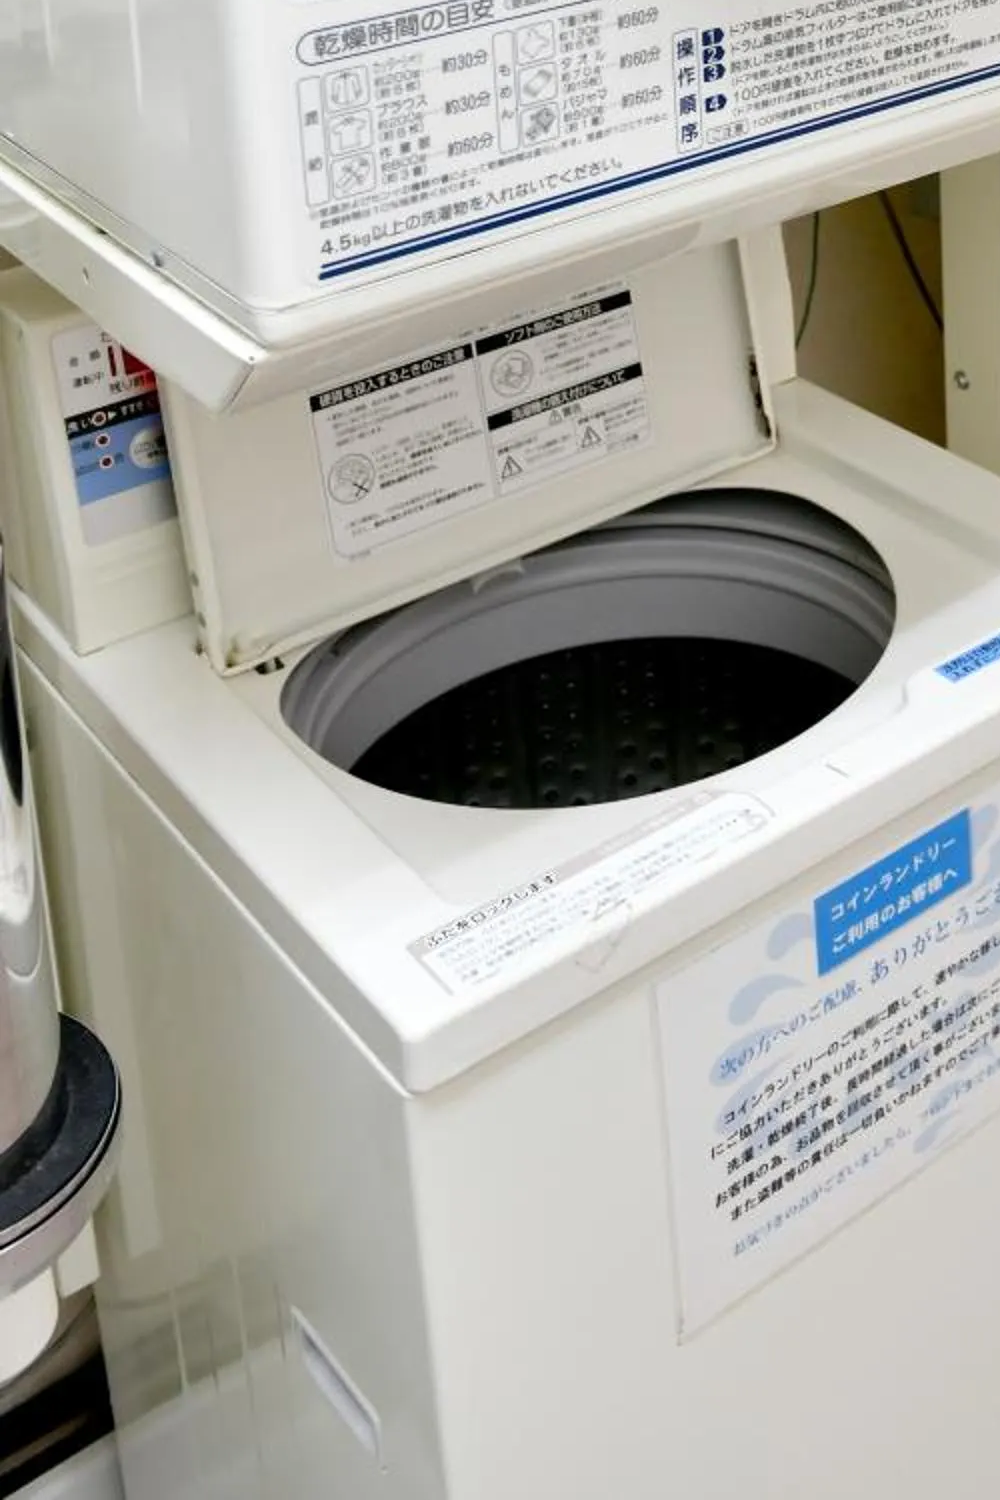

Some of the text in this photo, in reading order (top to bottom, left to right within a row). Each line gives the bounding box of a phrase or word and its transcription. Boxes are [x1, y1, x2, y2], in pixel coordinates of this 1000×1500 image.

[445, 91, 491, 115] 約30分
[676, 36, 699, 144] 操作順序
[830, 835, 957, 923] コインランドリー
[830, 867, 959, 955] ご利用のお客様へ
